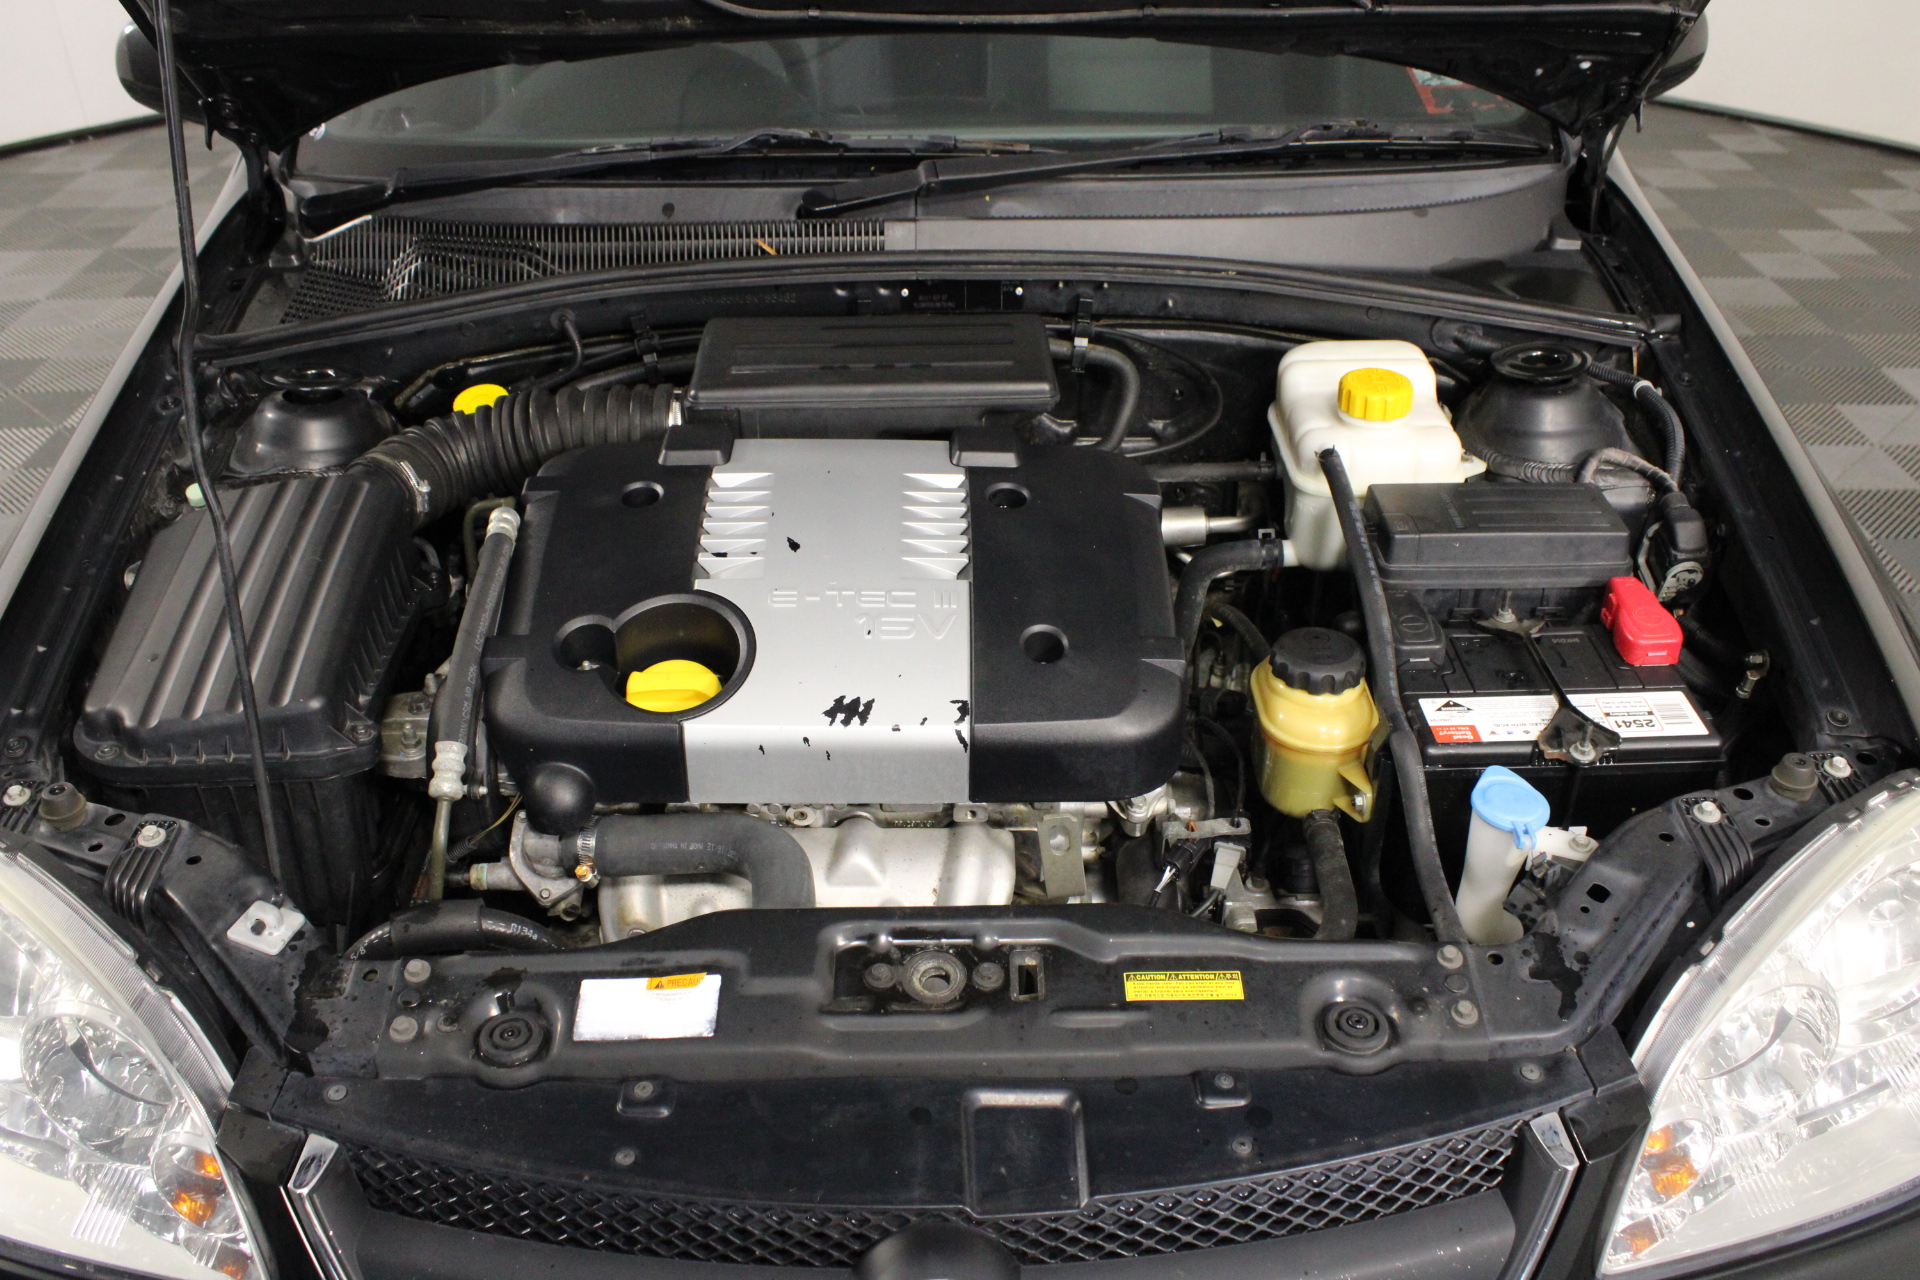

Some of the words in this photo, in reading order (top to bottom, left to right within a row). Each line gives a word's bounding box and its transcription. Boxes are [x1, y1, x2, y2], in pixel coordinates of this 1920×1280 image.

[768, 589, 916, 608] E-TEC
[855, 613, 957, 639] 16V
[1614, 719, 1655, 728] 2541
[510, 923, 538, 940] R134a
